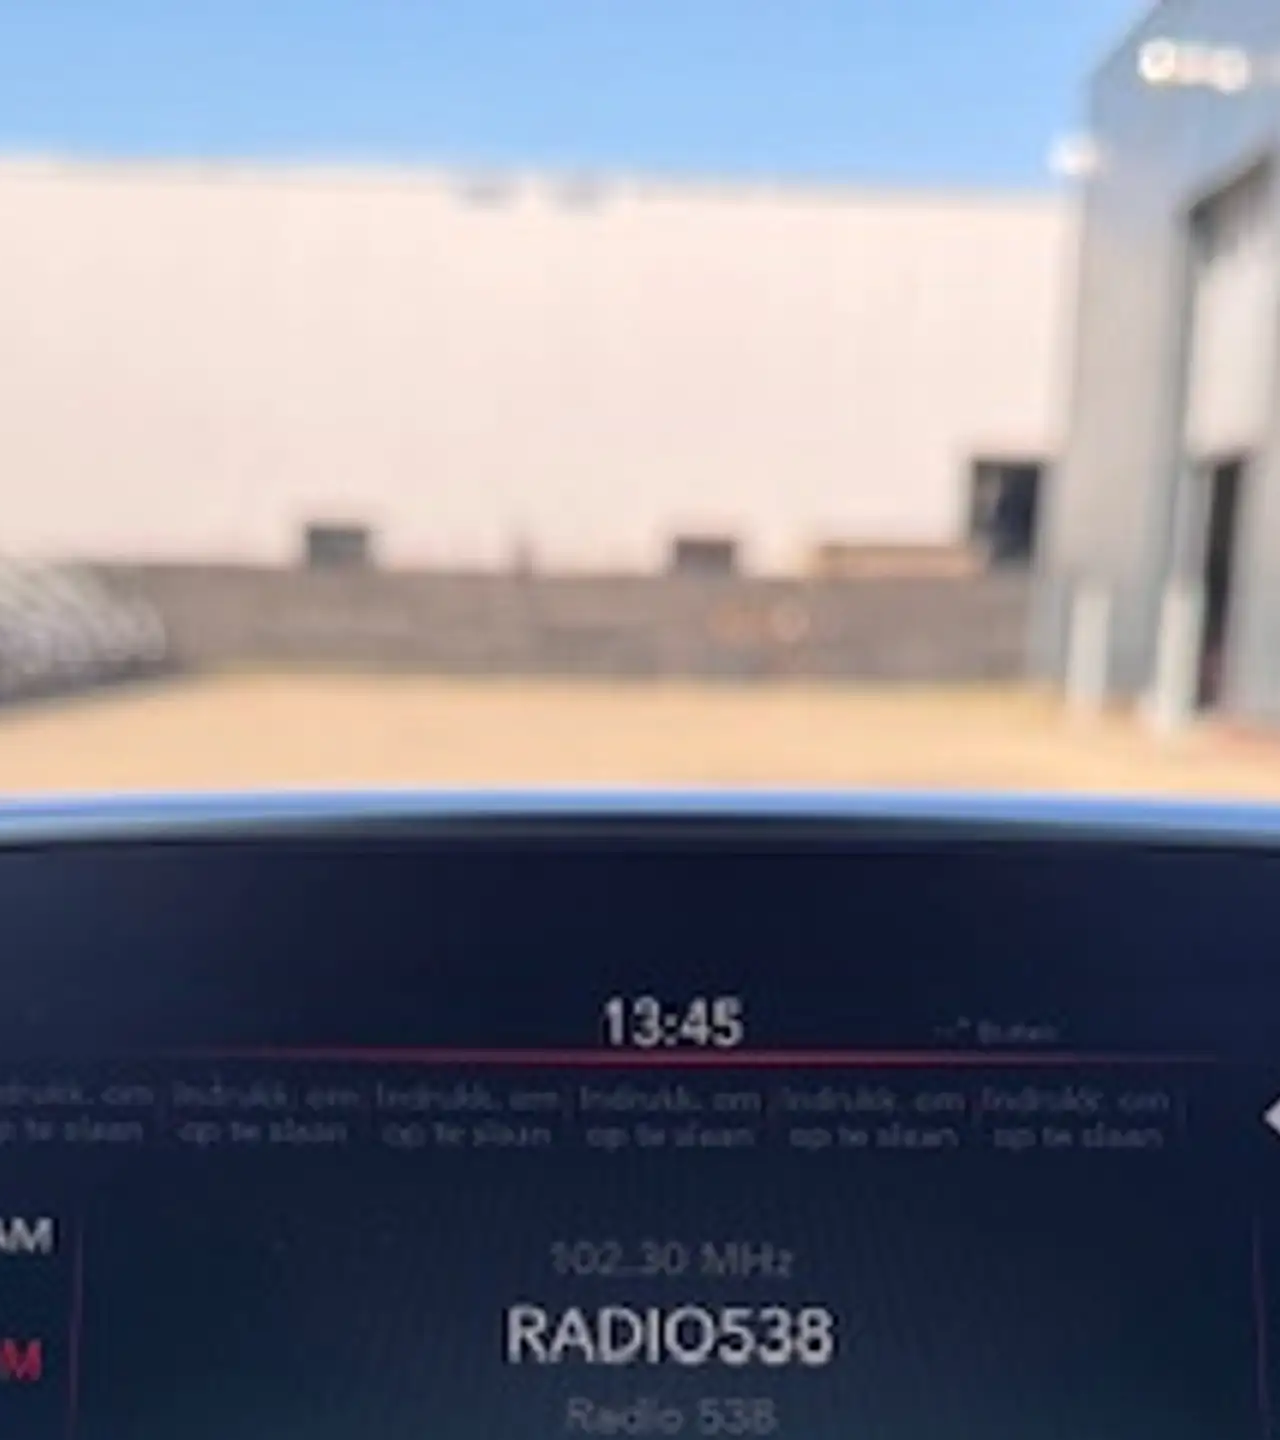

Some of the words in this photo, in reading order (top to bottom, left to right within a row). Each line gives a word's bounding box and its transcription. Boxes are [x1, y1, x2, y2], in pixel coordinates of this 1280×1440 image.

[603, 997, 745, 1048] 13:45
[549, 1240, 690, 1276] 102.30
[700, 1240, 794, 1278] MHz
[507, 1303, 835, 1367] RADIO538
[566, 1396, 685, 1436] Radio
[696, 1396, 781, 1437] 538
